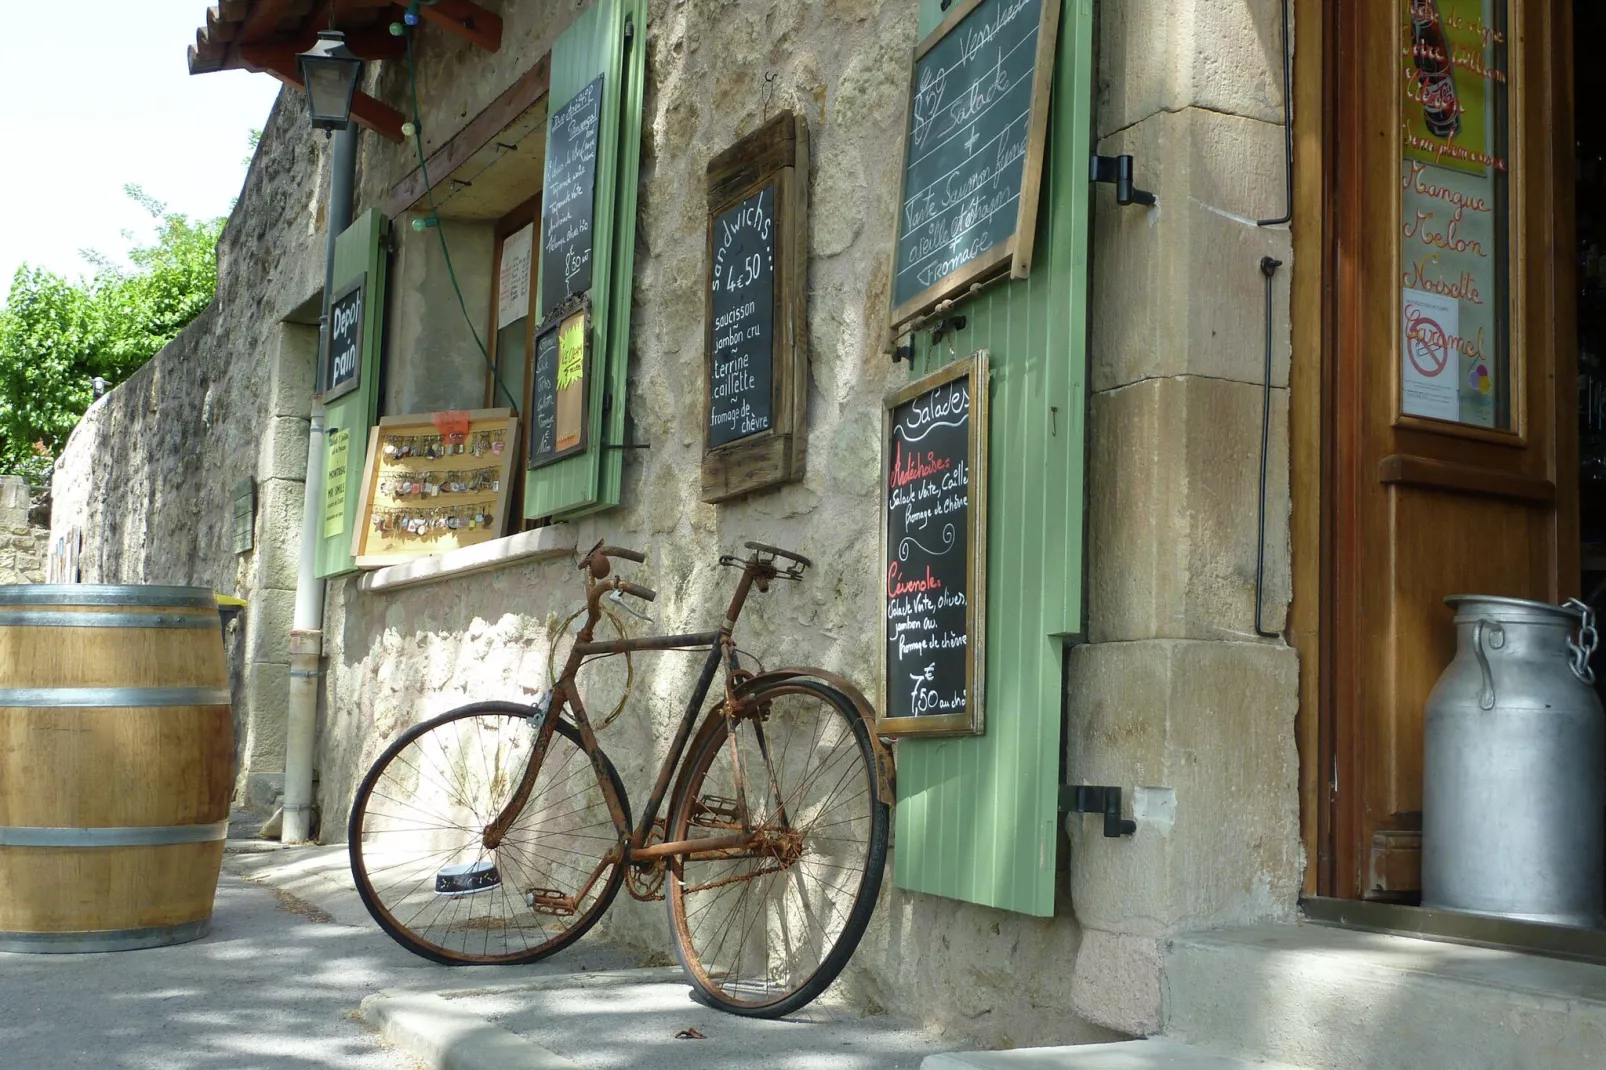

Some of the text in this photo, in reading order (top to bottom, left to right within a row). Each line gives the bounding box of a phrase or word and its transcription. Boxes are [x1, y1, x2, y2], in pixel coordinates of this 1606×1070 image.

[1402, 160, 1492, 221] Mangue
[712, 191, 771, 291] sandwichs
[1403, 209, 1488, 257] Melon
[1403, 253, 1483, 304] Noisette
[715, 300, 755, 331] saucisson
[714, 323, 760, 354] jambon cru
[1404, 304, 1487, 360] Caramel
[332, 340, 356, 388] pain
[714, 353, 749, 379] terrine
[714, 370, 755, 399] caillette
[710, 398, 750, 430] fromage de
[907, 382, 969, 428] Salades
[741, 412, 769, 433] chèvre
[889, 483, 915, 510] Salade
[905, 504, 932, 533] fromage
[934, 500, 943, 516] de
[888, 595, 912, 619] Salade
[898, 631, 967, 660] fromage de chèvre
[951, 689, 967, 709] cho
